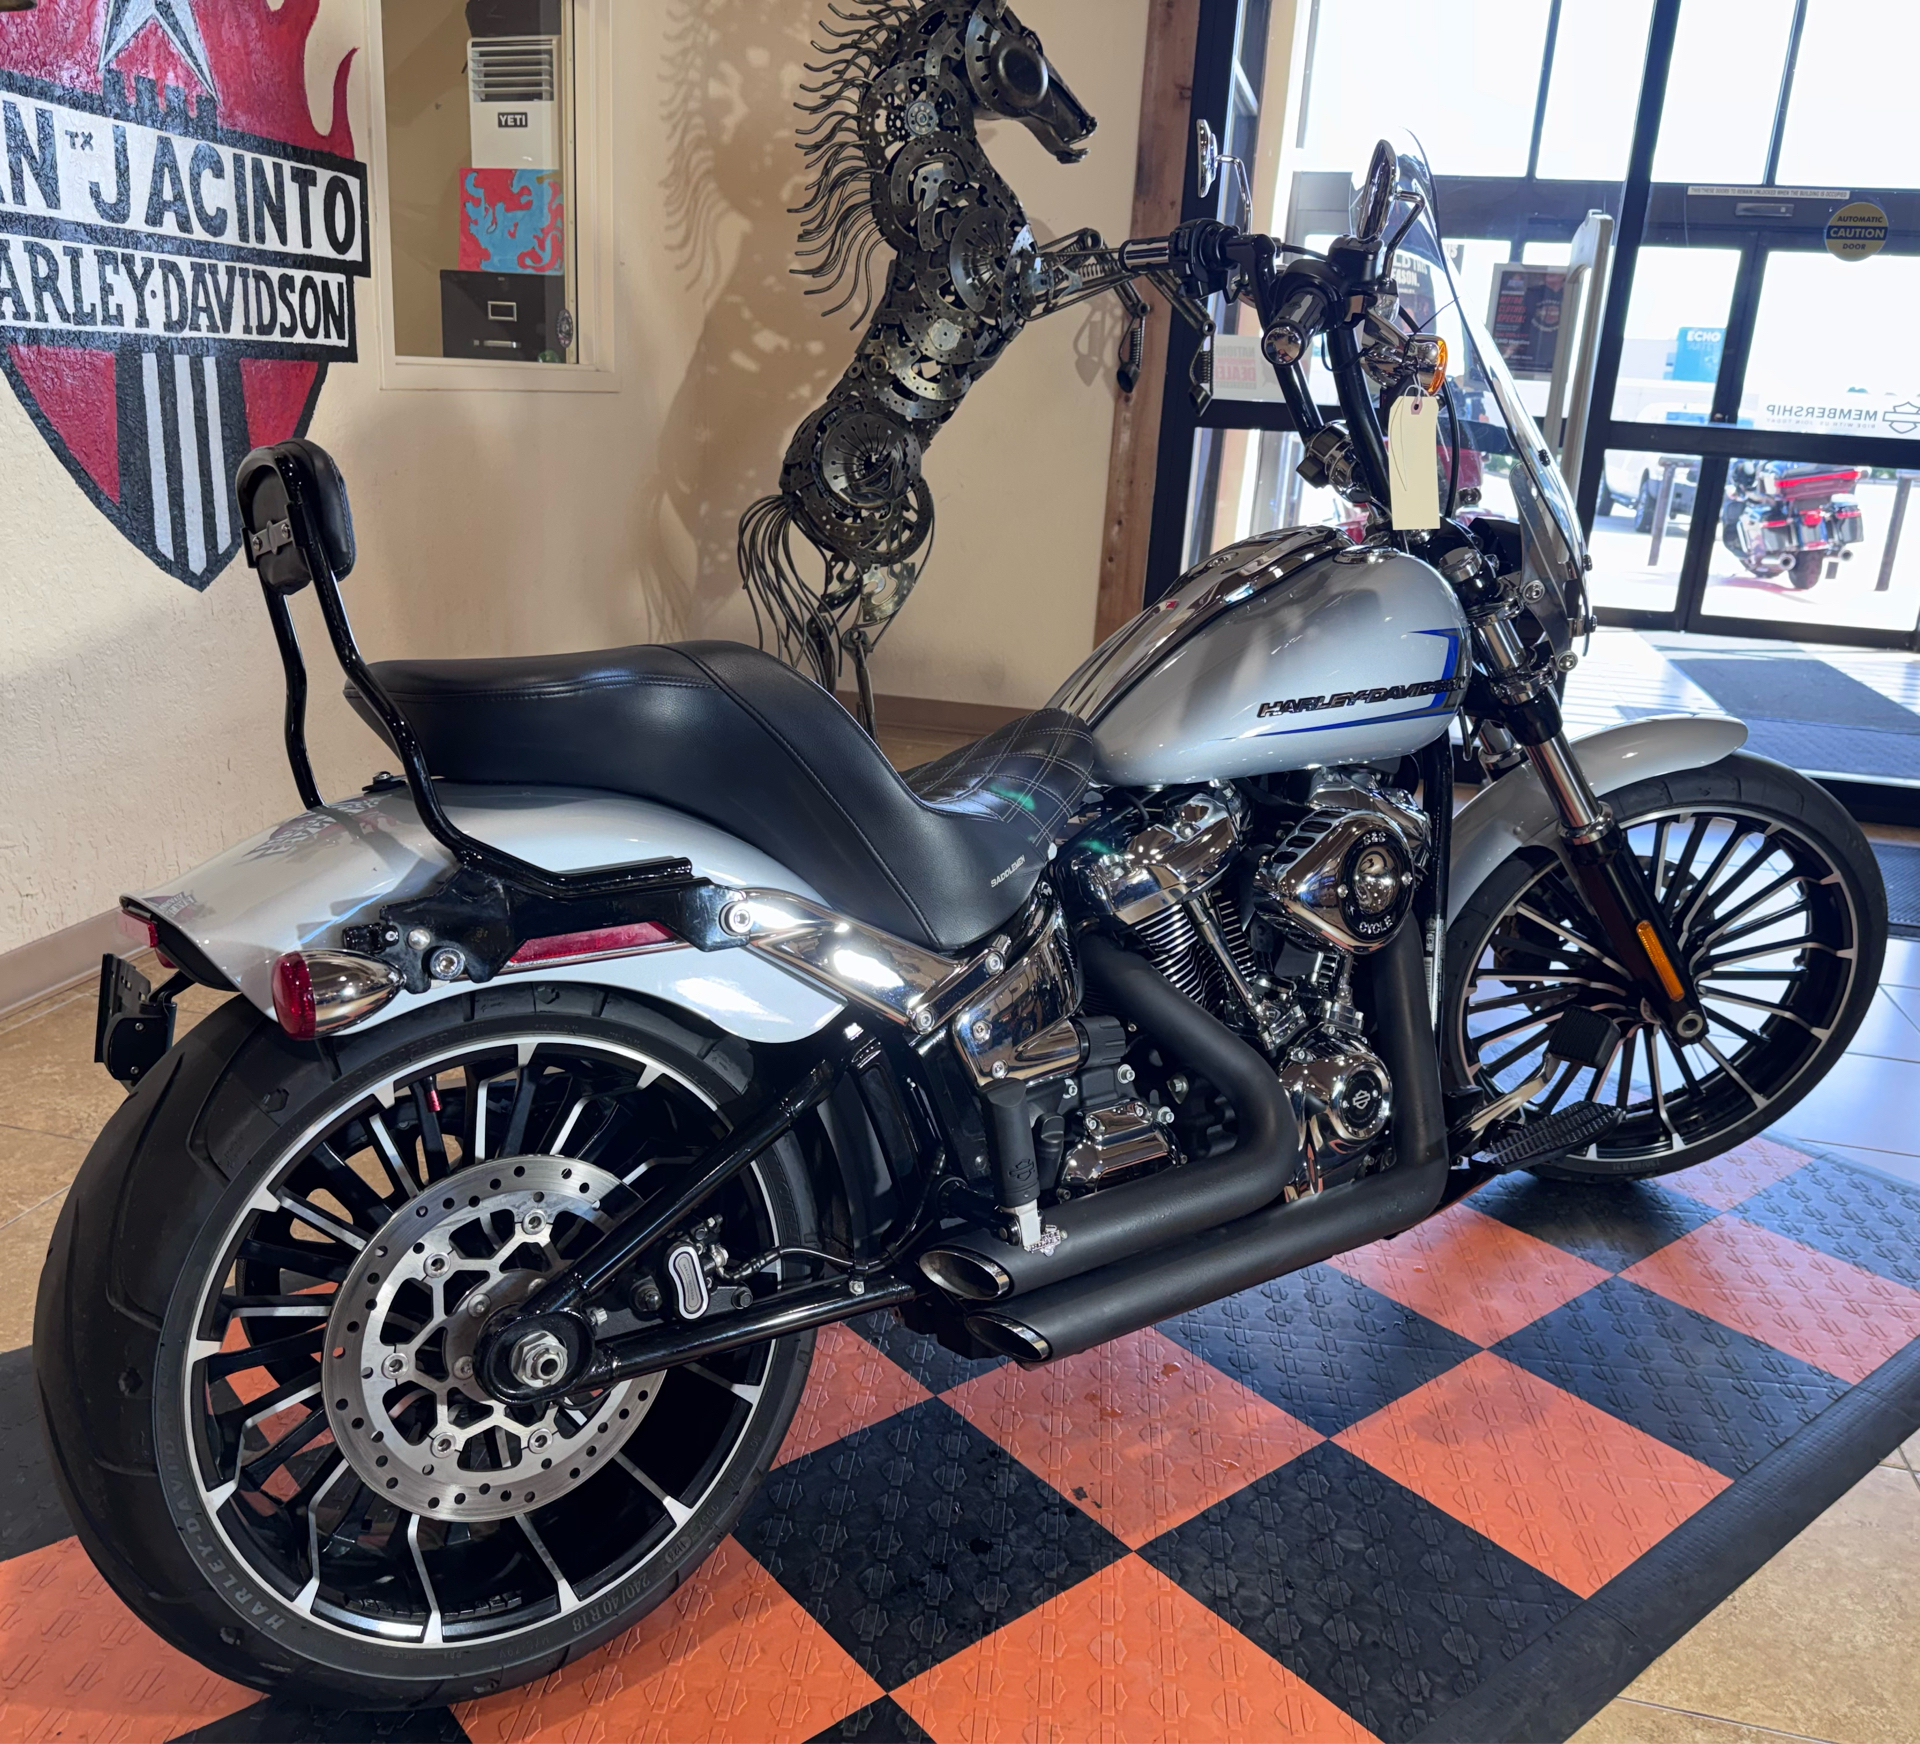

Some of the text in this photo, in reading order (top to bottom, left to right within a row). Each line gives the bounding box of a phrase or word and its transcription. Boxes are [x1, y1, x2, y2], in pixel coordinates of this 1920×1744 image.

[499, 115, 527, 126] YETI
[0, 104, 356, 256] N TX JACINTO
[1836, 215, 1883, 223] AUTOMATIC
[1830, 227, 1885, 238] CAUTION
[1391, 268, 1420, 287] EASON.
[1687, 330, 1721, 342] ECHO
[1257, 676, 1467, 718] HARLEY-DAVIDSON
[1363, 831, 1387, 845] S&S
[990, 854, 1026, 888] SADDLEMEN
[1360, 915, 1393, 934] CYCLE
